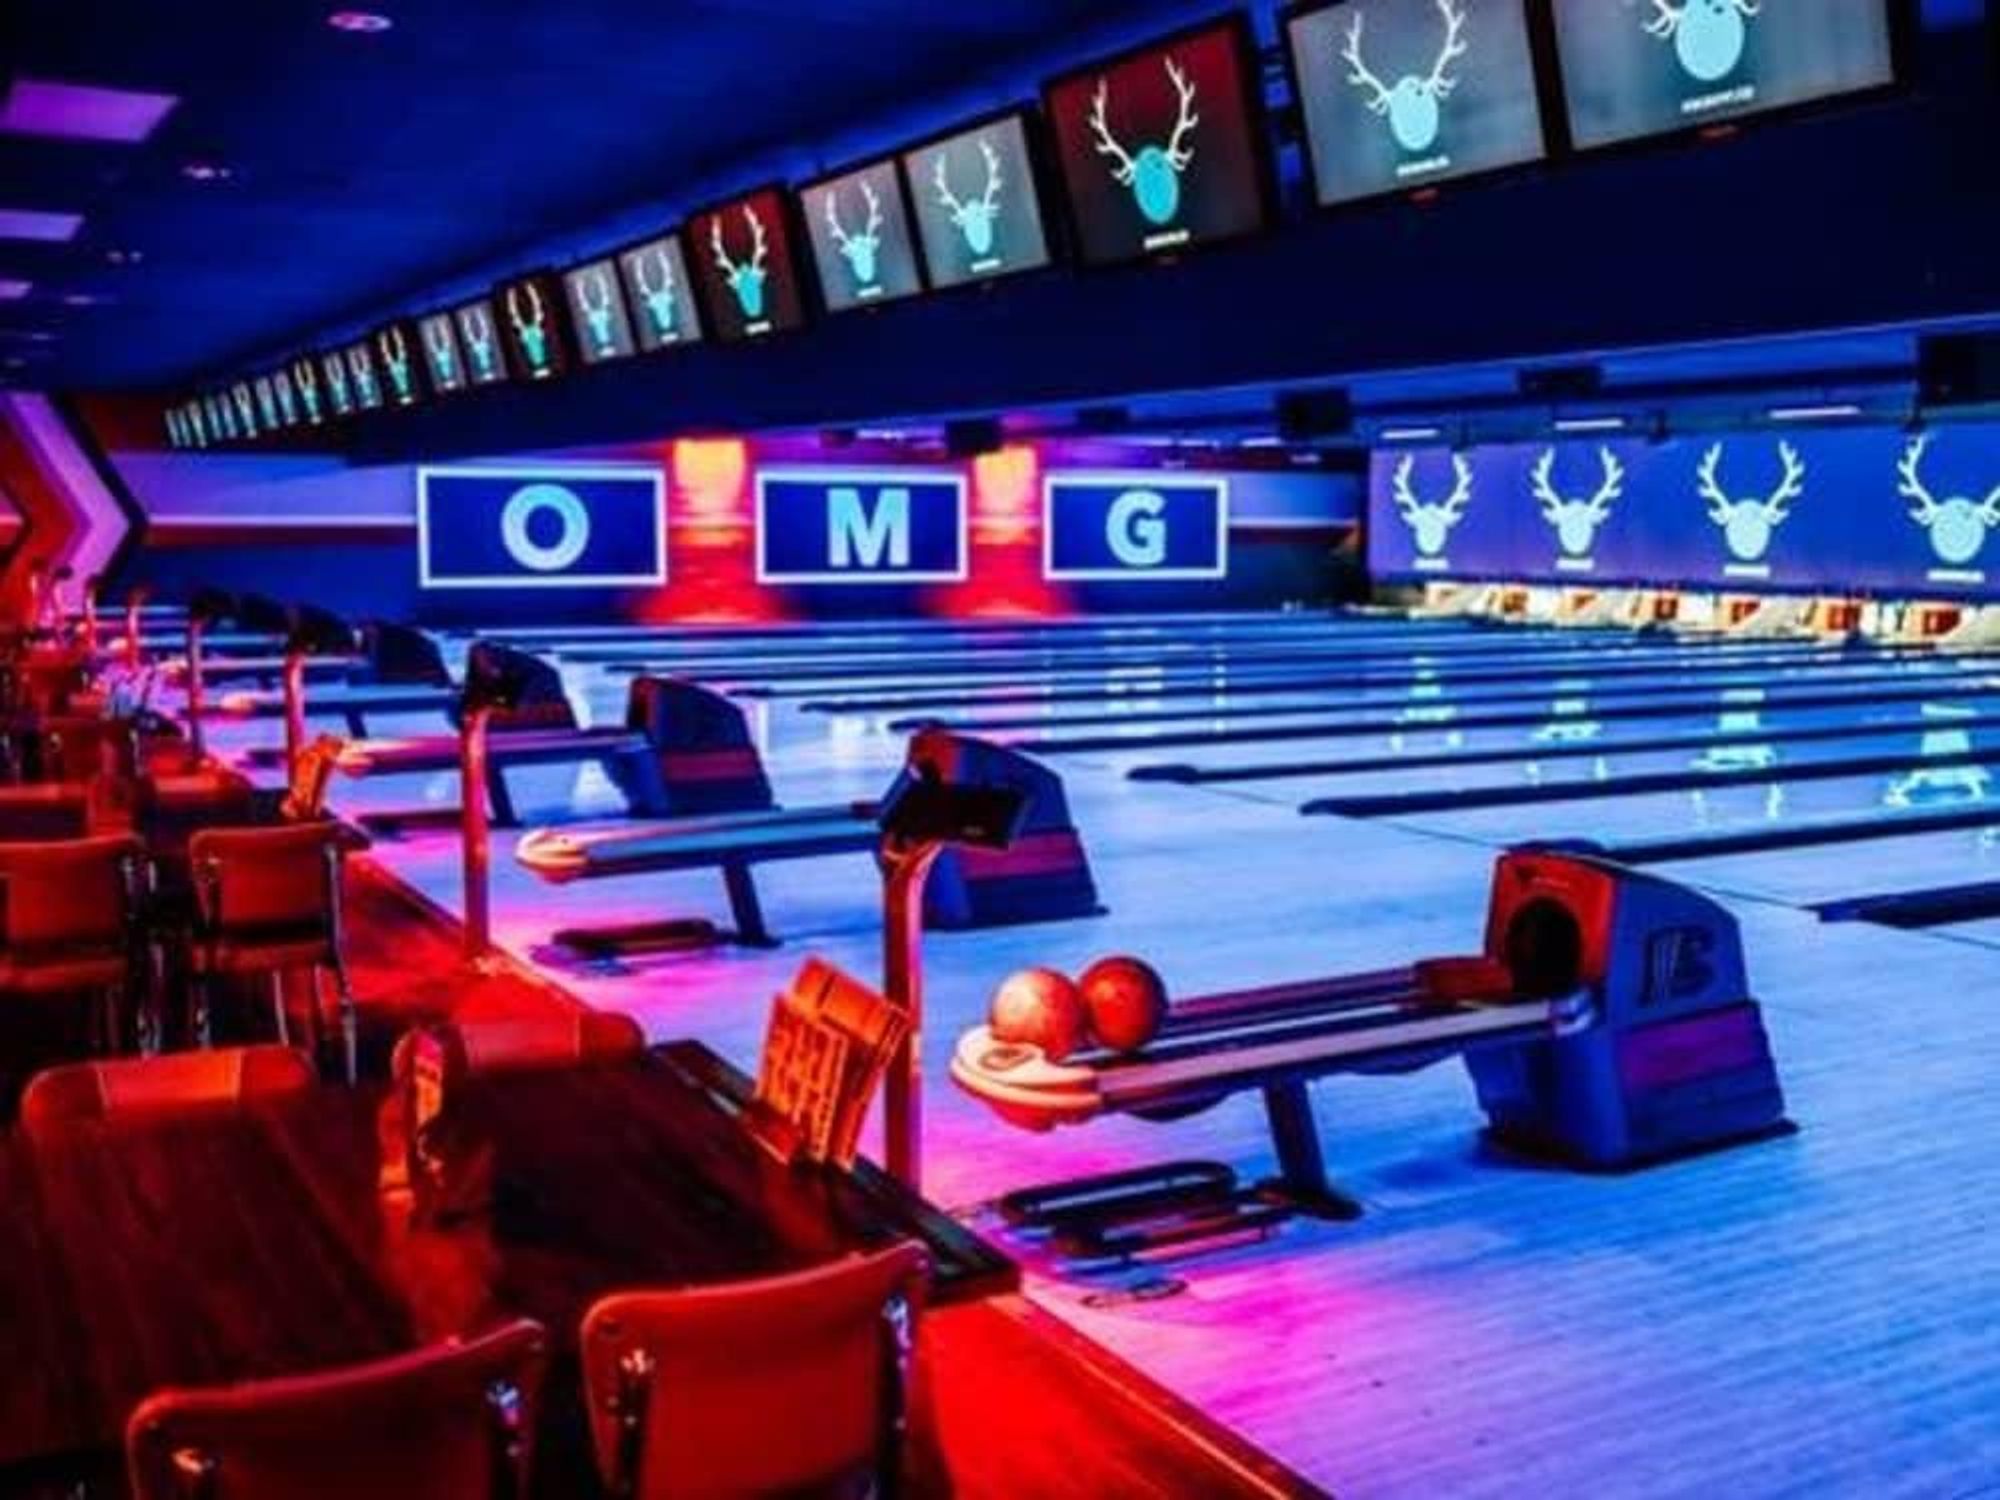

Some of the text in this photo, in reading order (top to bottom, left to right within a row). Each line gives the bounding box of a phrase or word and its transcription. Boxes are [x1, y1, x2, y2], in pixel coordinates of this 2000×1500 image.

[501, 484, 1167, 571] O M G
